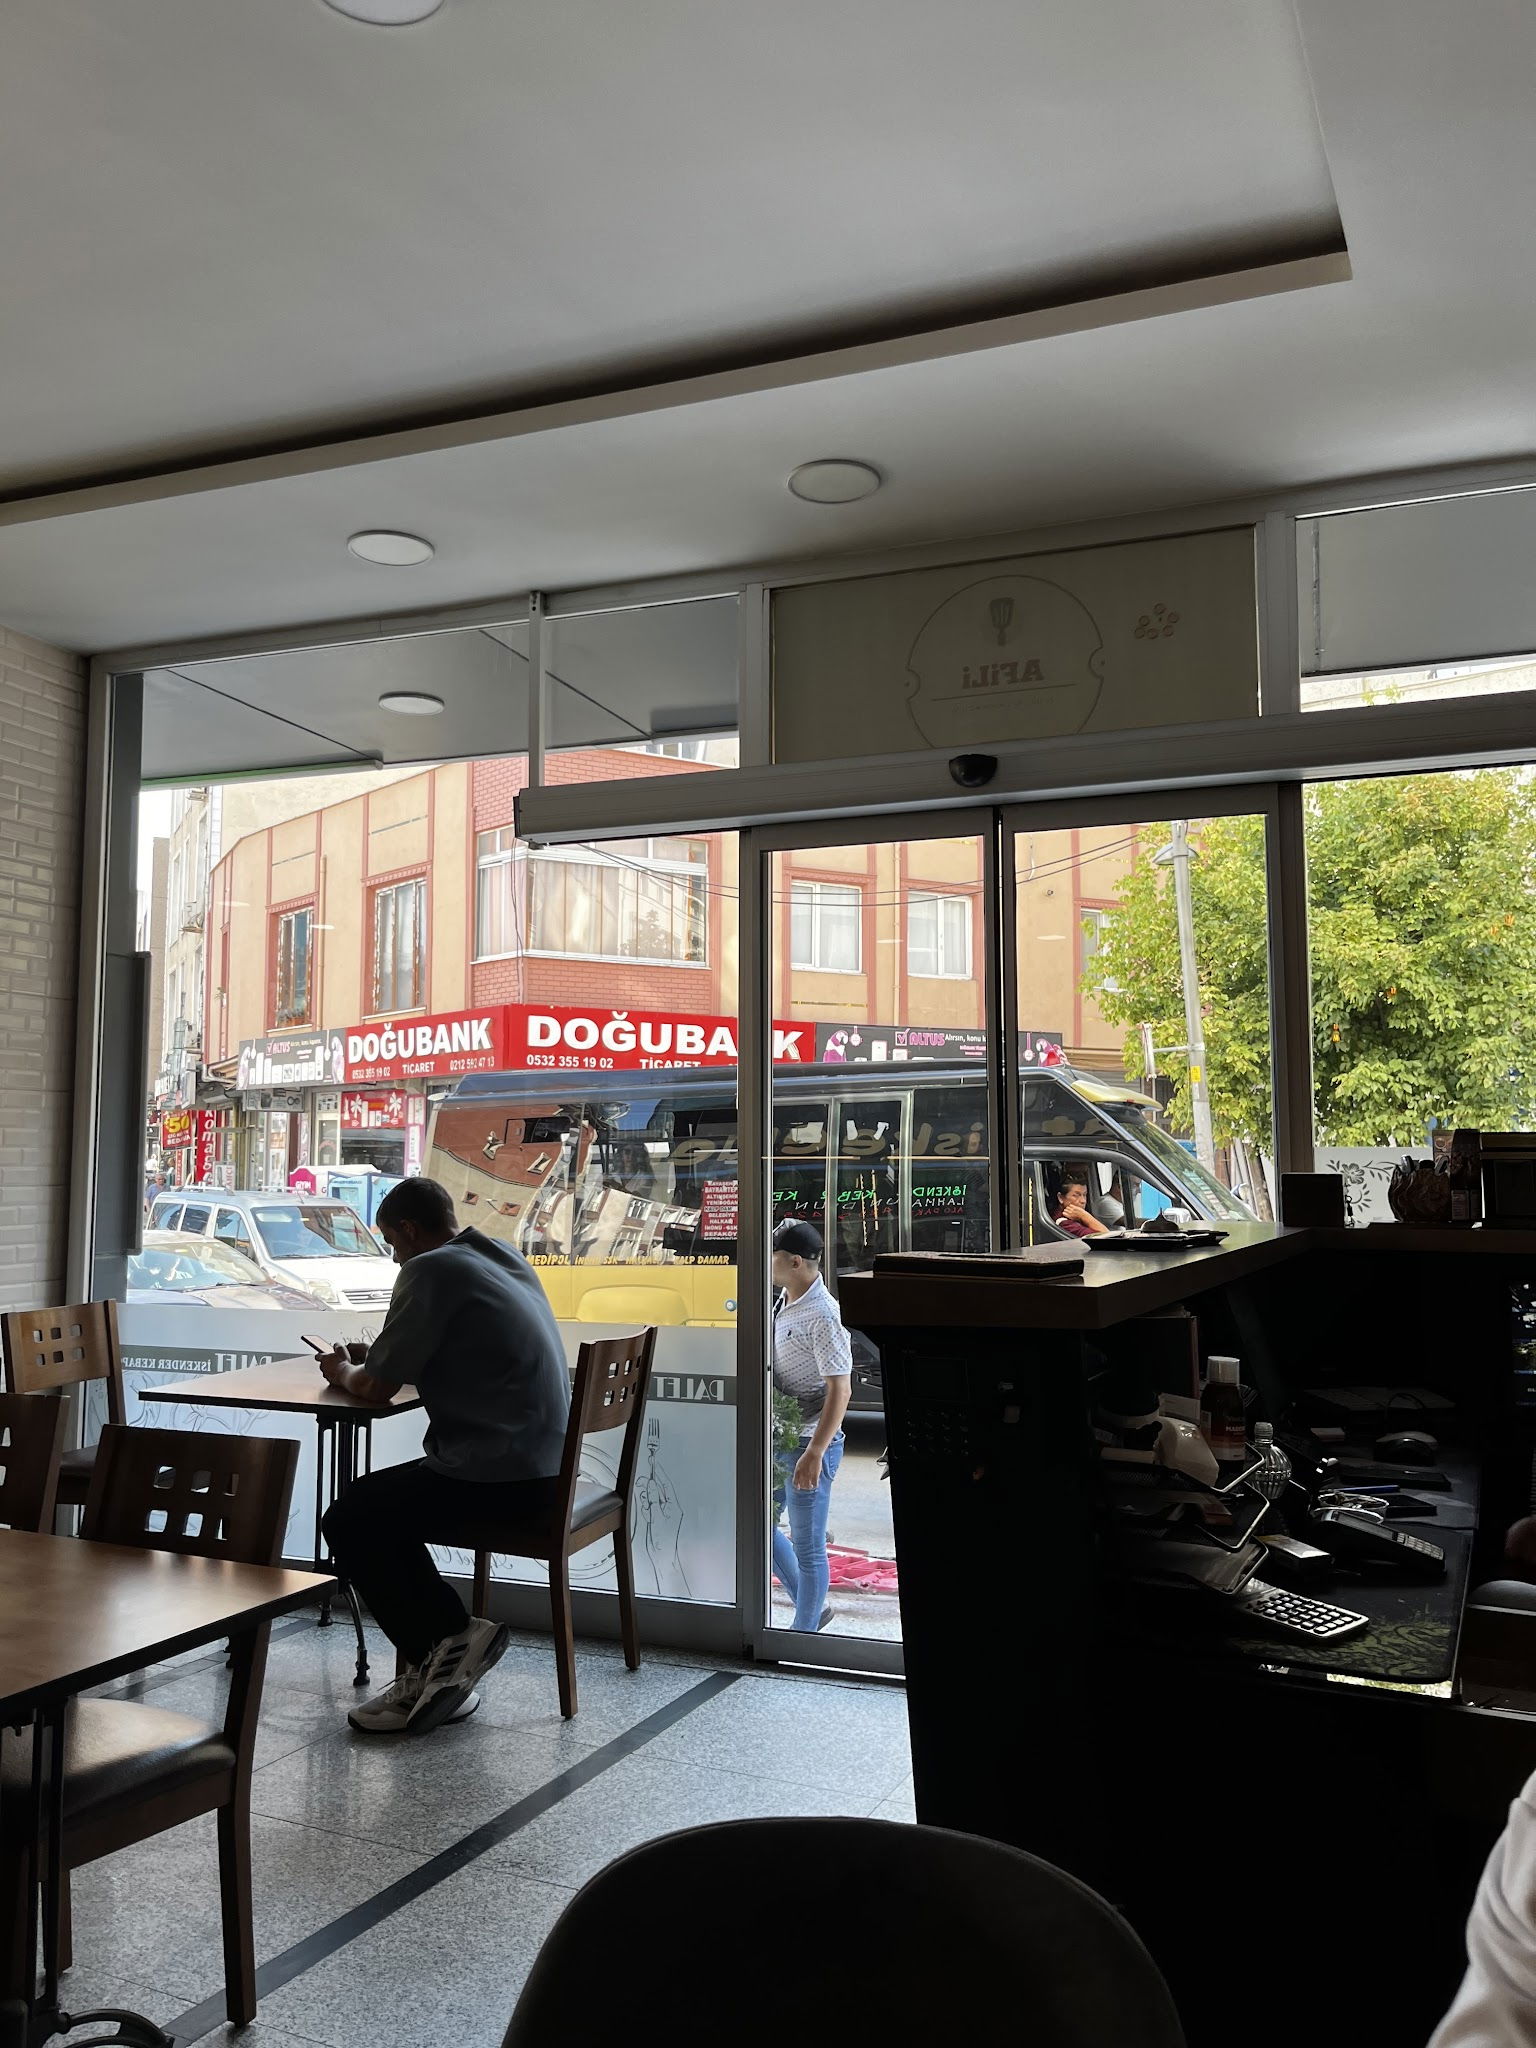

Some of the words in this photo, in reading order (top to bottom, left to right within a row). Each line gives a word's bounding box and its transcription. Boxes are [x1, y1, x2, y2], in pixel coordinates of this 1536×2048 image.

[348, 1017, 492, 1064] DOĞUBANK
[527, 1010, 804, 1060] DOĞUBAK
[909, 1031, 946, 1047] ALTUS
[402, 1061, 435, 1074] TİCARET
[450, 1059, 465, 1071] 0212
[526, 1054, 556, 1067] 0532
[558, 1055, 579, 1068] 355
[582, 1056, 597, 1069] 19
[599, 1057, 614, 1069] 02
[696, 1255, 730, 1265] DAMAR
